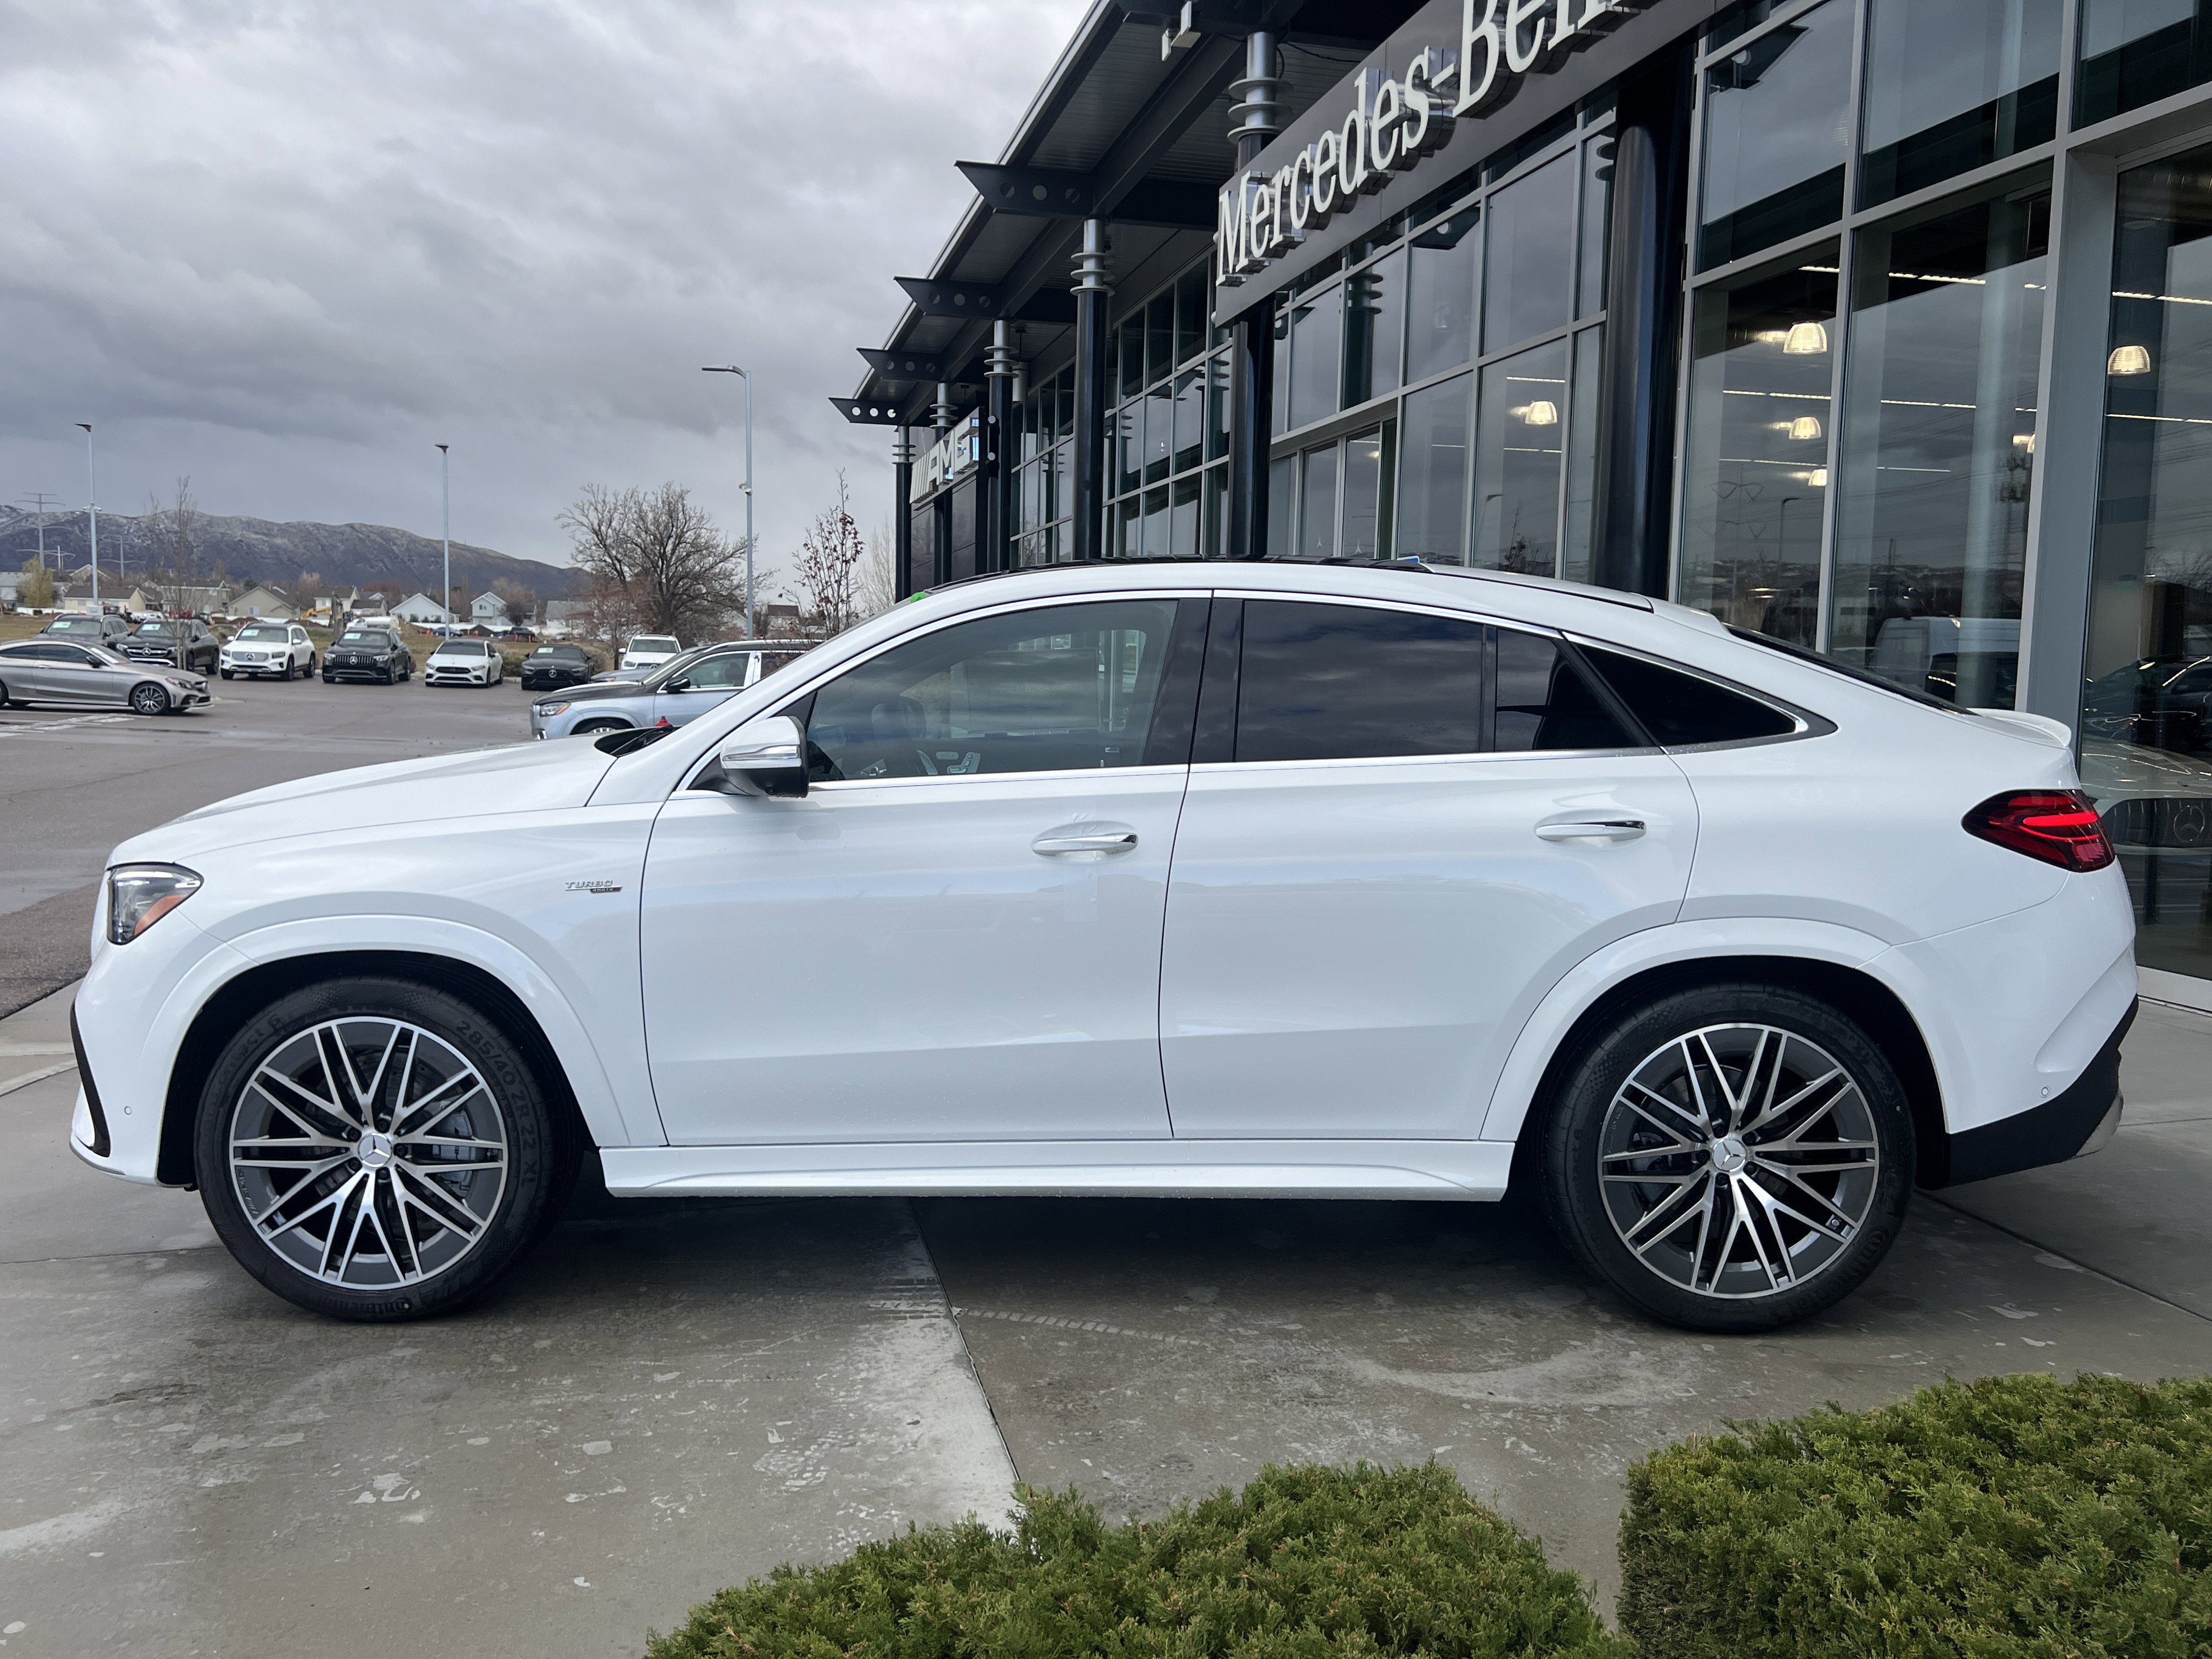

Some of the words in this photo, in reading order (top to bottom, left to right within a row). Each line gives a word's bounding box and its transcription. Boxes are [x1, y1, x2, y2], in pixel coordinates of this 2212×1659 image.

[926, 417, 970, 492] AMG
[565, 880, 613, 888] TURBO
[456, 1020, 516, 1086] 285/40
[510, 1090, 531, 1120] ZR
[521, 1122, 537, 1150] 22
[522, 1159, 538, 1183] XL
